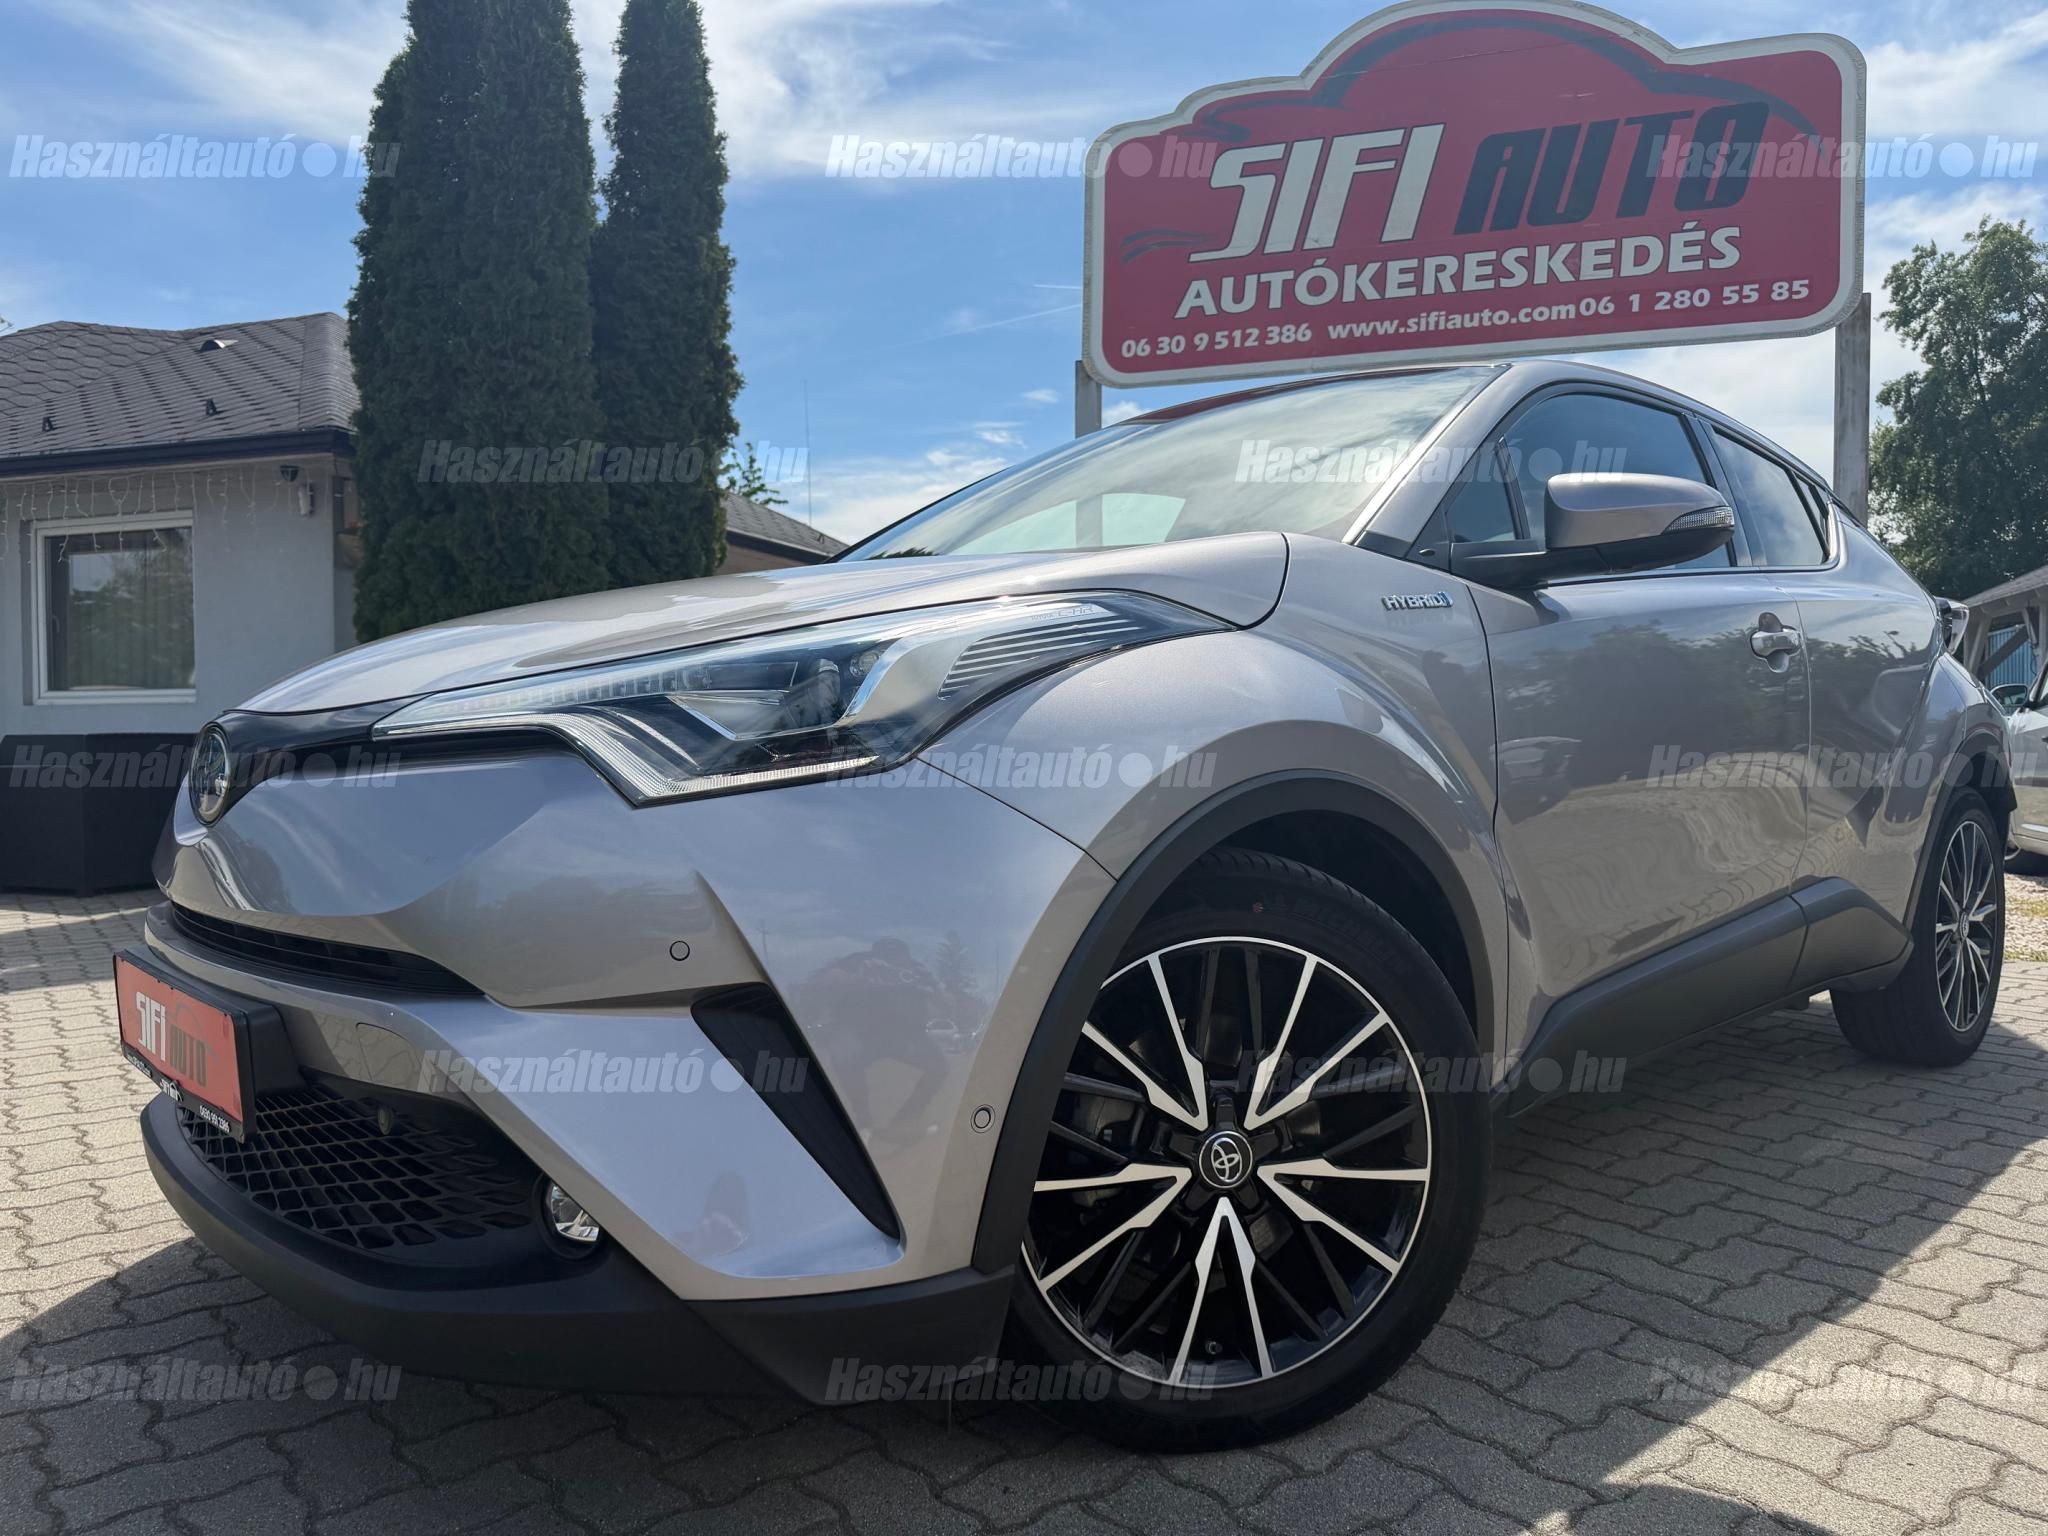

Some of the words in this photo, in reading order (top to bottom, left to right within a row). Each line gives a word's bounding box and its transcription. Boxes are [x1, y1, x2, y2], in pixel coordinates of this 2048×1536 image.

[1189, 121, 1445, 263] SIFI
[1453, 101, 1770, 236] AUTO
[1174, 221, 1743, 320] AUTÓKERESKEDÉS
[1121, 338, 1151, 358] 06
[1156, 335, 1185, 355] 30
[1193, 331, 1210, 351] 9
[1214, 328, 1259, 349] 512
[1265, 323, 1312, 345] 386
[1327, 304, 1576, 340] www.sifiauto.com
[1579, 296, 1615, 316] 06
[1628, 294, 1641, 312] 1
[1654, 288, 1711, 310] 280
[1722, 284, 1760, 305] 55
[1771, 279, 1810, 301] 85
[1382, 593, 1446, 611] HYBRID
[136, 991, 166, 1062] SIFI
